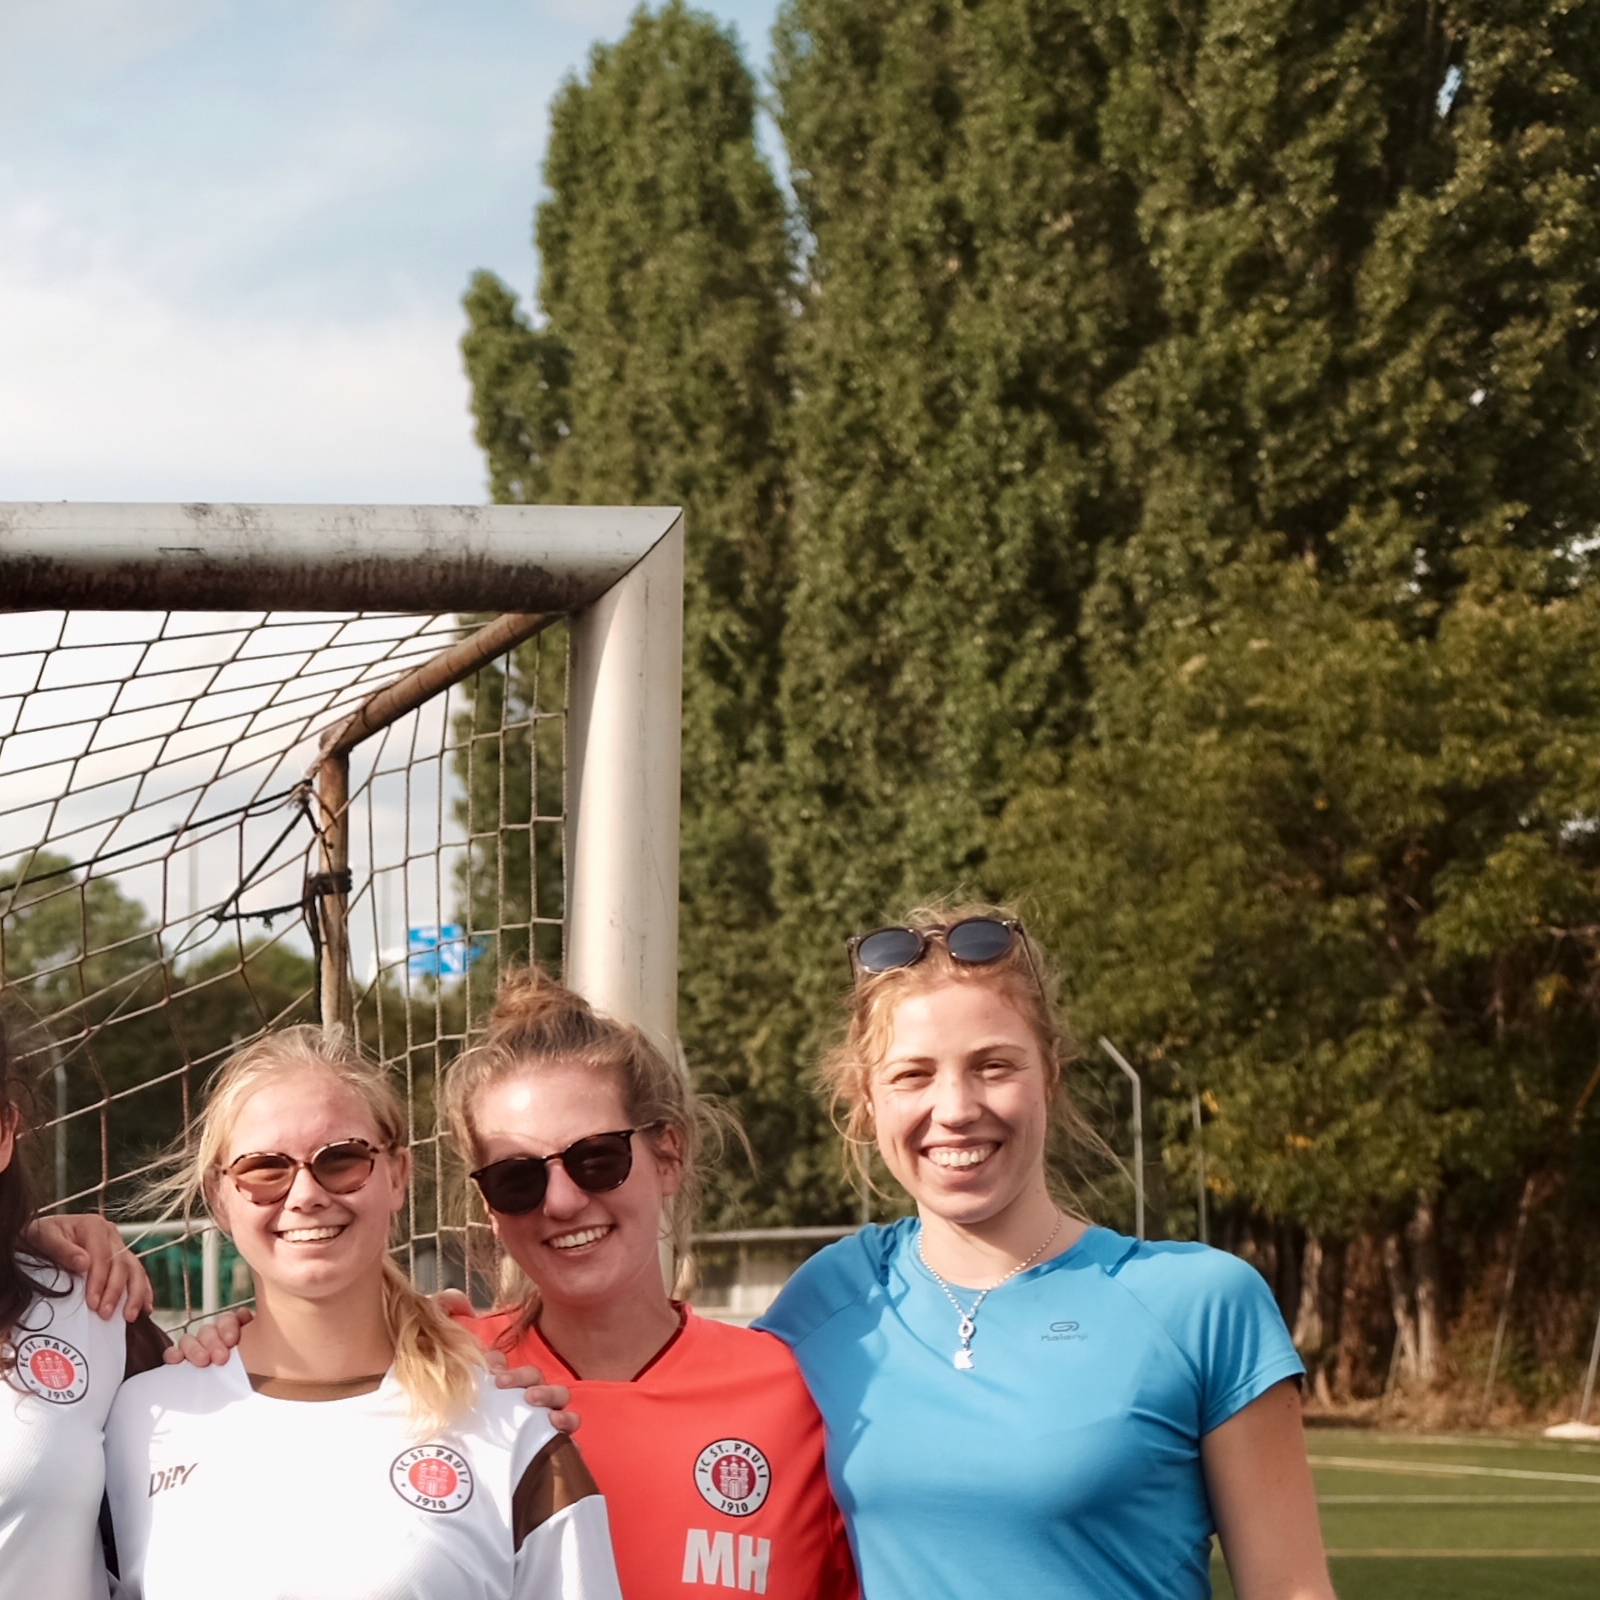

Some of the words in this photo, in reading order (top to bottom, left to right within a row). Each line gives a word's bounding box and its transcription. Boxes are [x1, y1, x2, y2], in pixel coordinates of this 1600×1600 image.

[19, 1353, 29, 1368] FC
[44, 1339, 84, 1368] PAULI
[47, 1390, 75, 1401] 1910
[396, 1459, 410, 1472] FC
[435, 1449, 469, 1484] PAULI
[699, 1460, 712, 1473] FC
[710, 1444, 729, 1457] ST.
[734, 1443, 768, 1479] PAULI
[415, 1495, 447, 1509] 1910
[721, 1500, 749, 1513] 1910
[682, 1528, 770, 1595] MH
